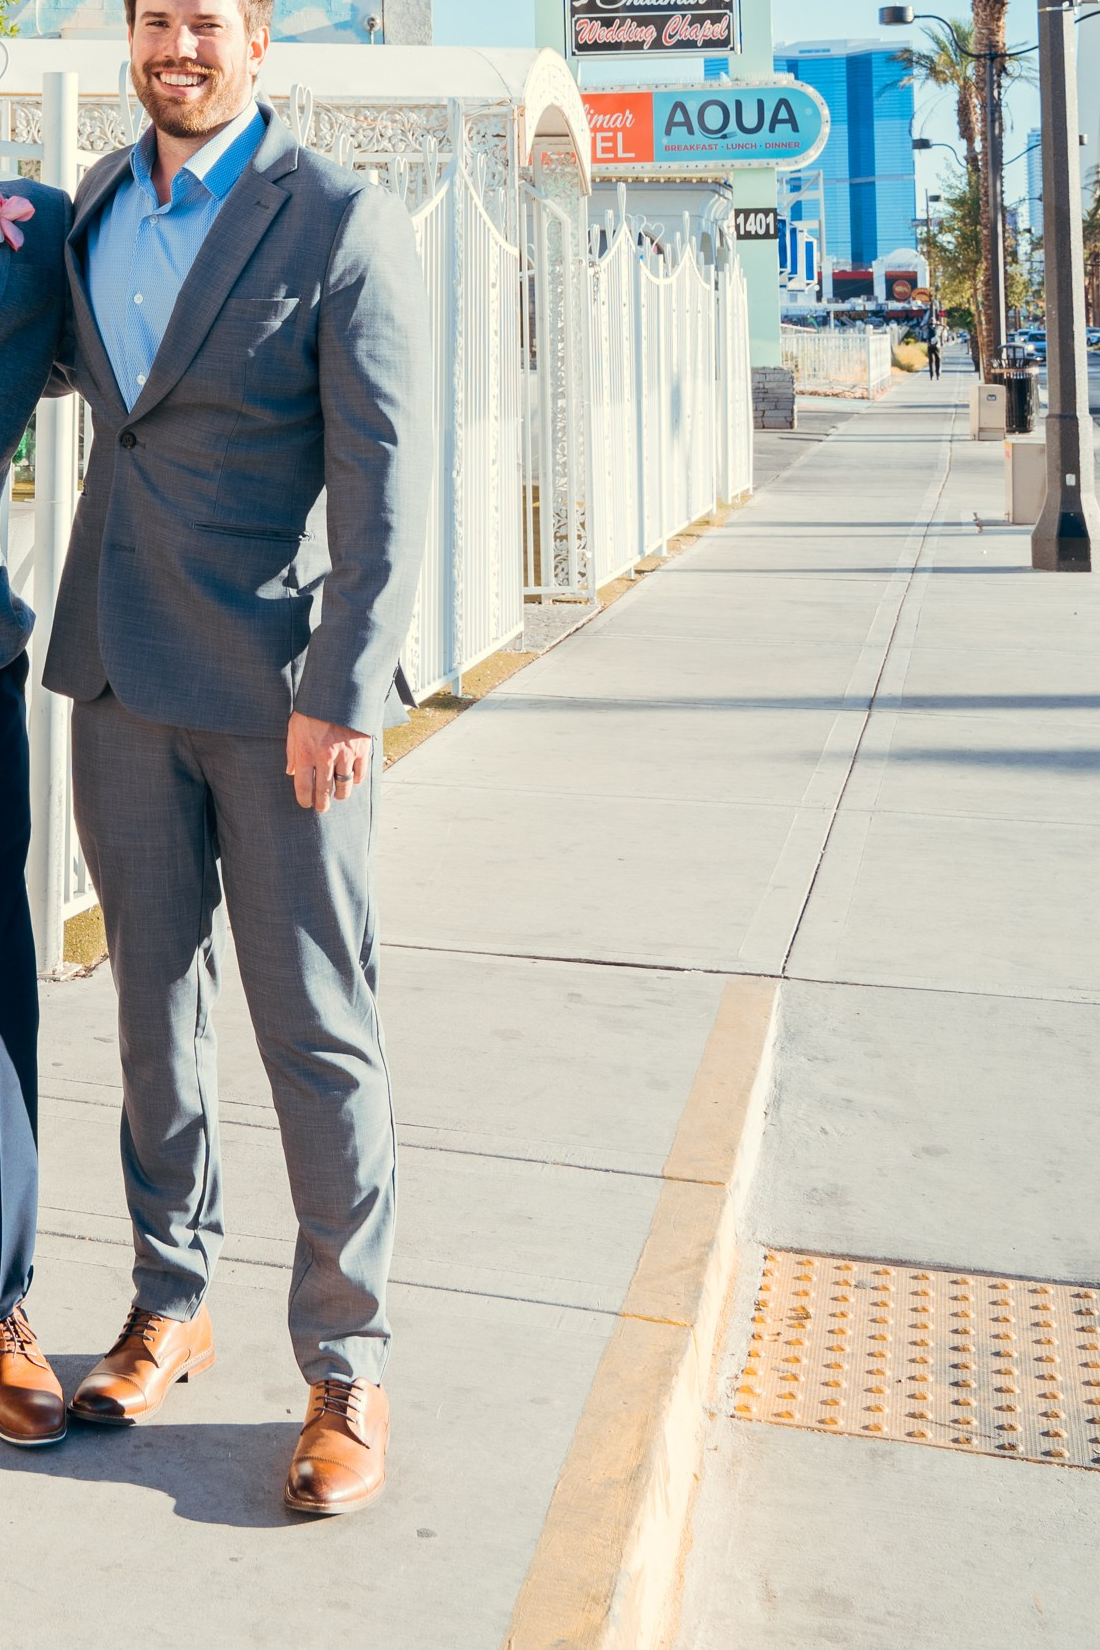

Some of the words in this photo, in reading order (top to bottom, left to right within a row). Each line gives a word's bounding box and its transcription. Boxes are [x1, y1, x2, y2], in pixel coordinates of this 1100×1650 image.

[575, 17, 657, 50] Wedding
[662, 14, 730, 47] Chapel
[664, 97, 800, 137] AQUA
[590, 131, 636, 159] EL
[664, 143, 719, 152] BREAKFAST
[725, 142, 757, 150] LUNCH
[764, 141, 800, 149] DINNER
[736, 212, 775, 235] 1401
